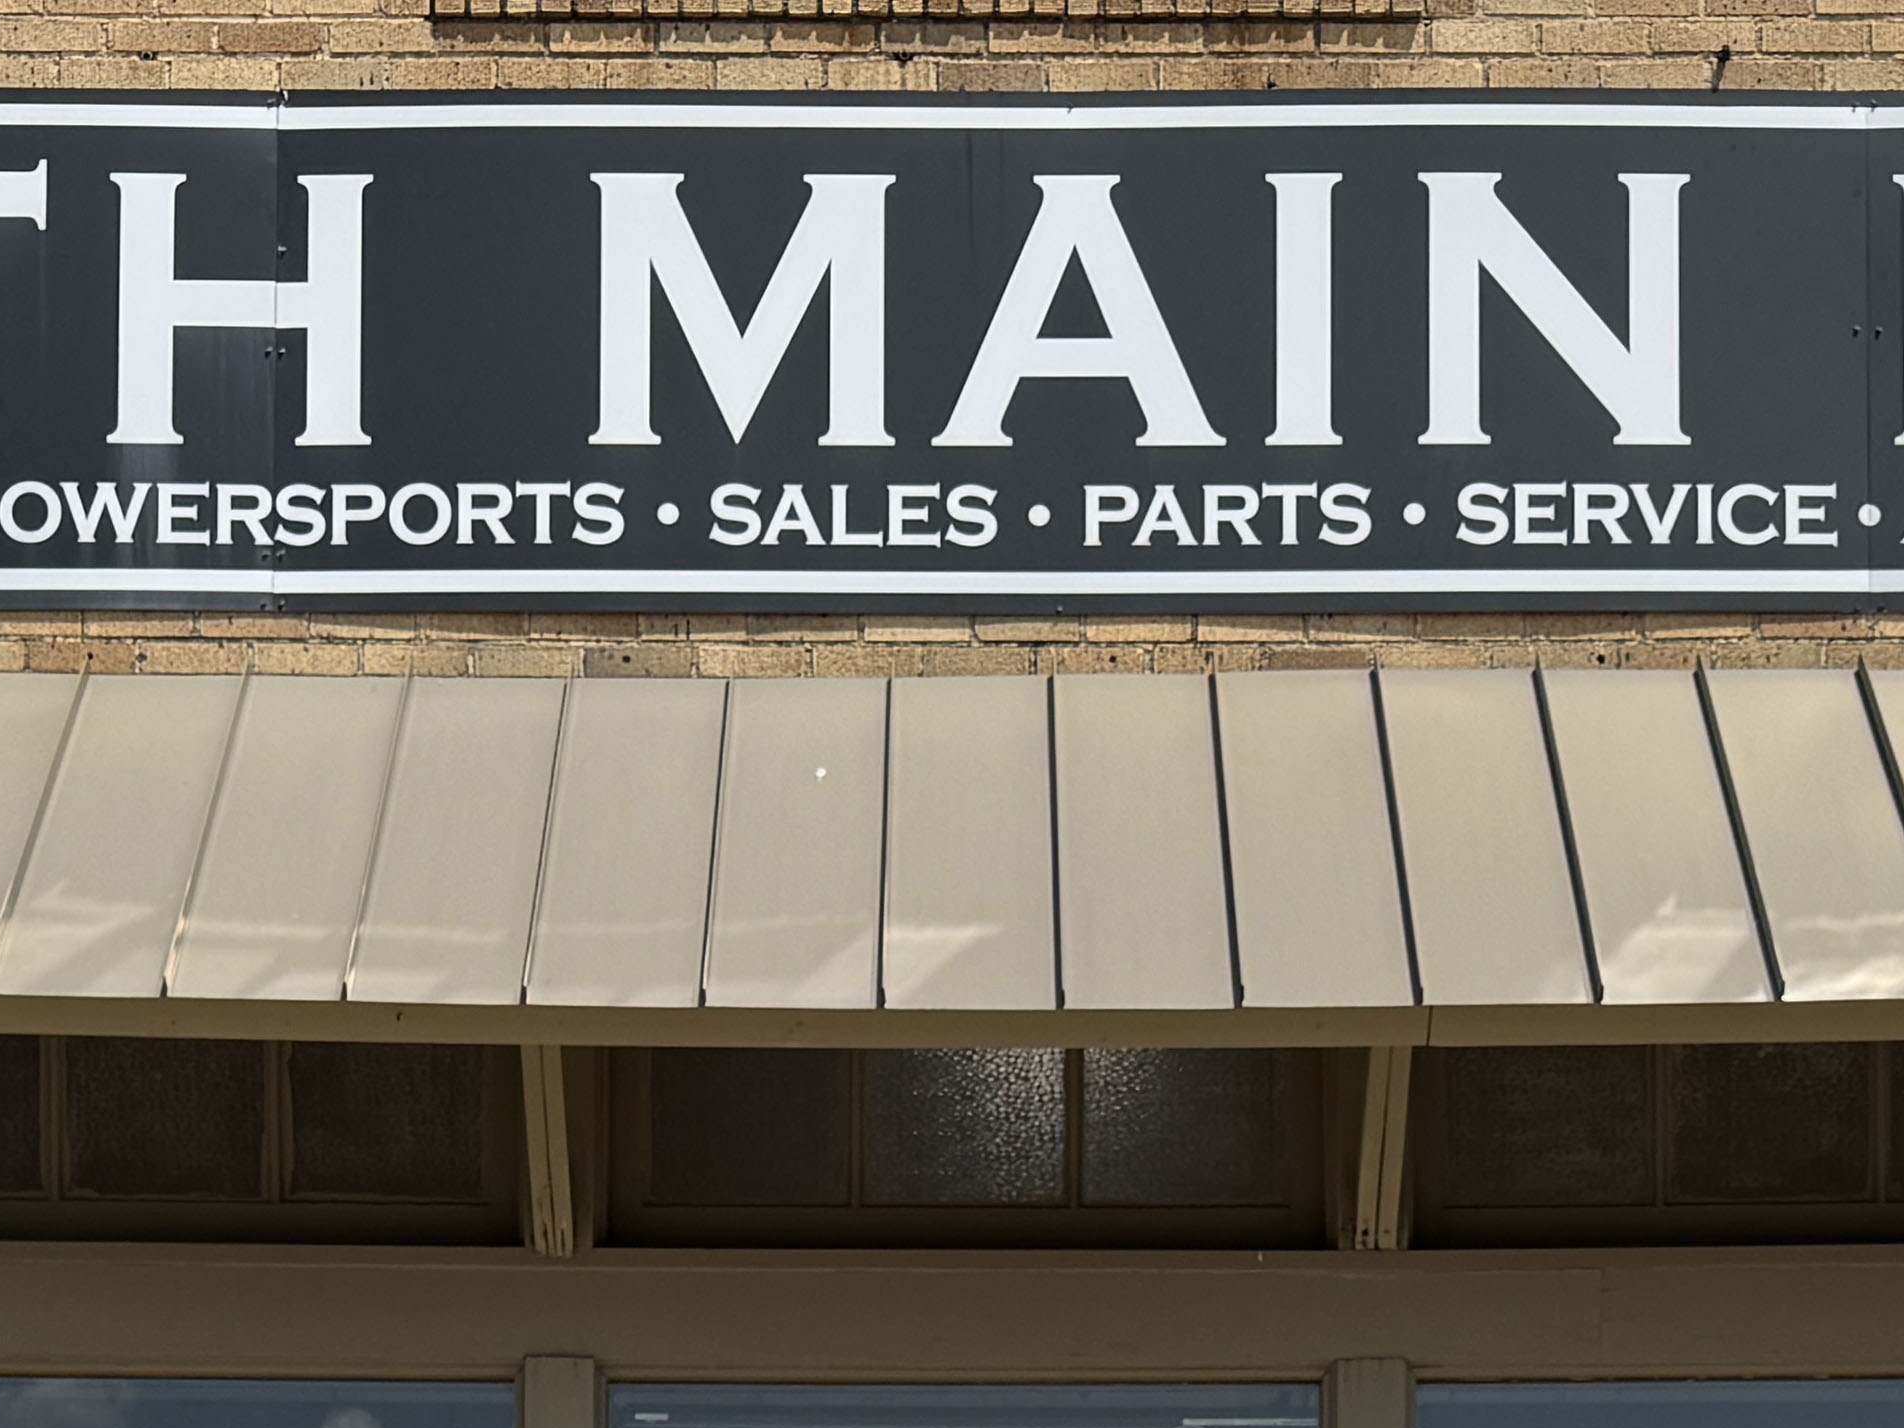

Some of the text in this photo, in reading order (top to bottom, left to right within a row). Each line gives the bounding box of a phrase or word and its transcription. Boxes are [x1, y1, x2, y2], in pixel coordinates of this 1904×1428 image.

[588, 172, 1691, 446] MAIN
[709, 483, 997, 547] SALES
[1084, 482, 1371, 546] PARTS
[1456, 481, 1838, 547] SERVICE
